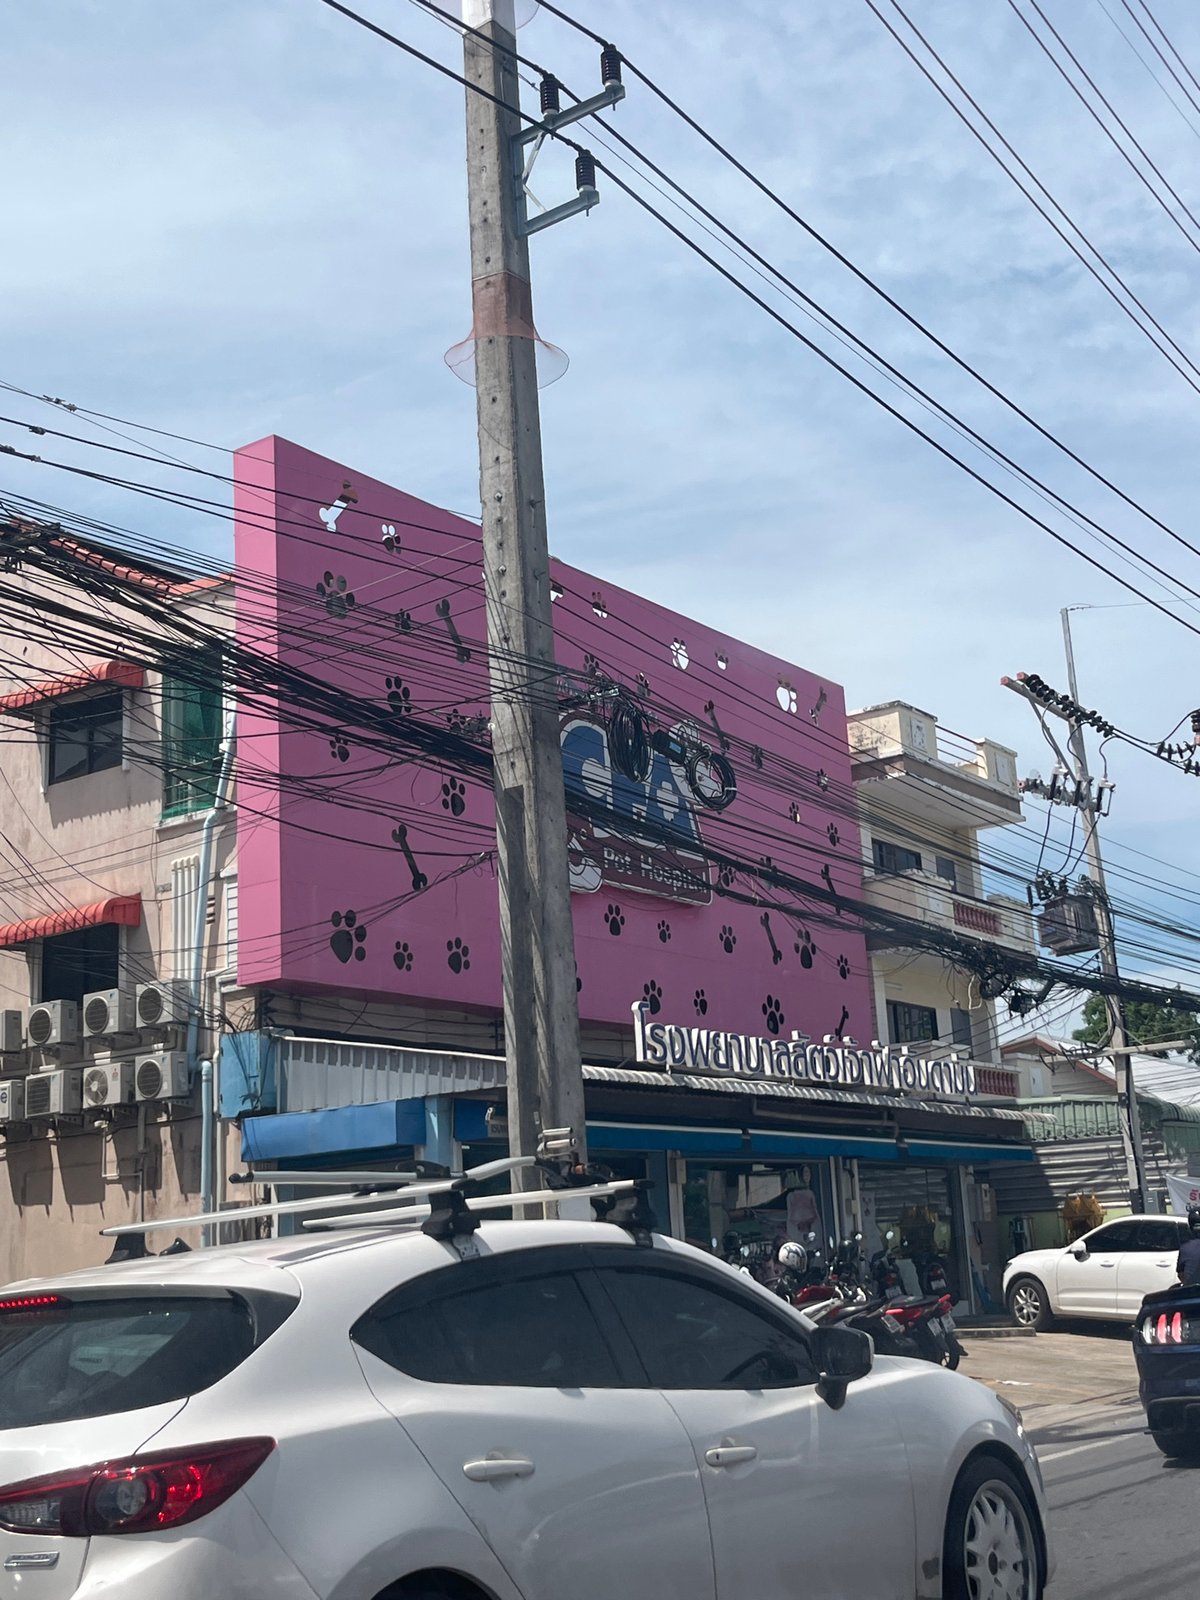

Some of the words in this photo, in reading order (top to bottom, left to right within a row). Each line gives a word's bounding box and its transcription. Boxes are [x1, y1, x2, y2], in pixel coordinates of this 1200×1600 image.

[631, 1000, 978, 1096] โรงพยาบาลสัตว์เจ้าฟ้าอันดามัน
